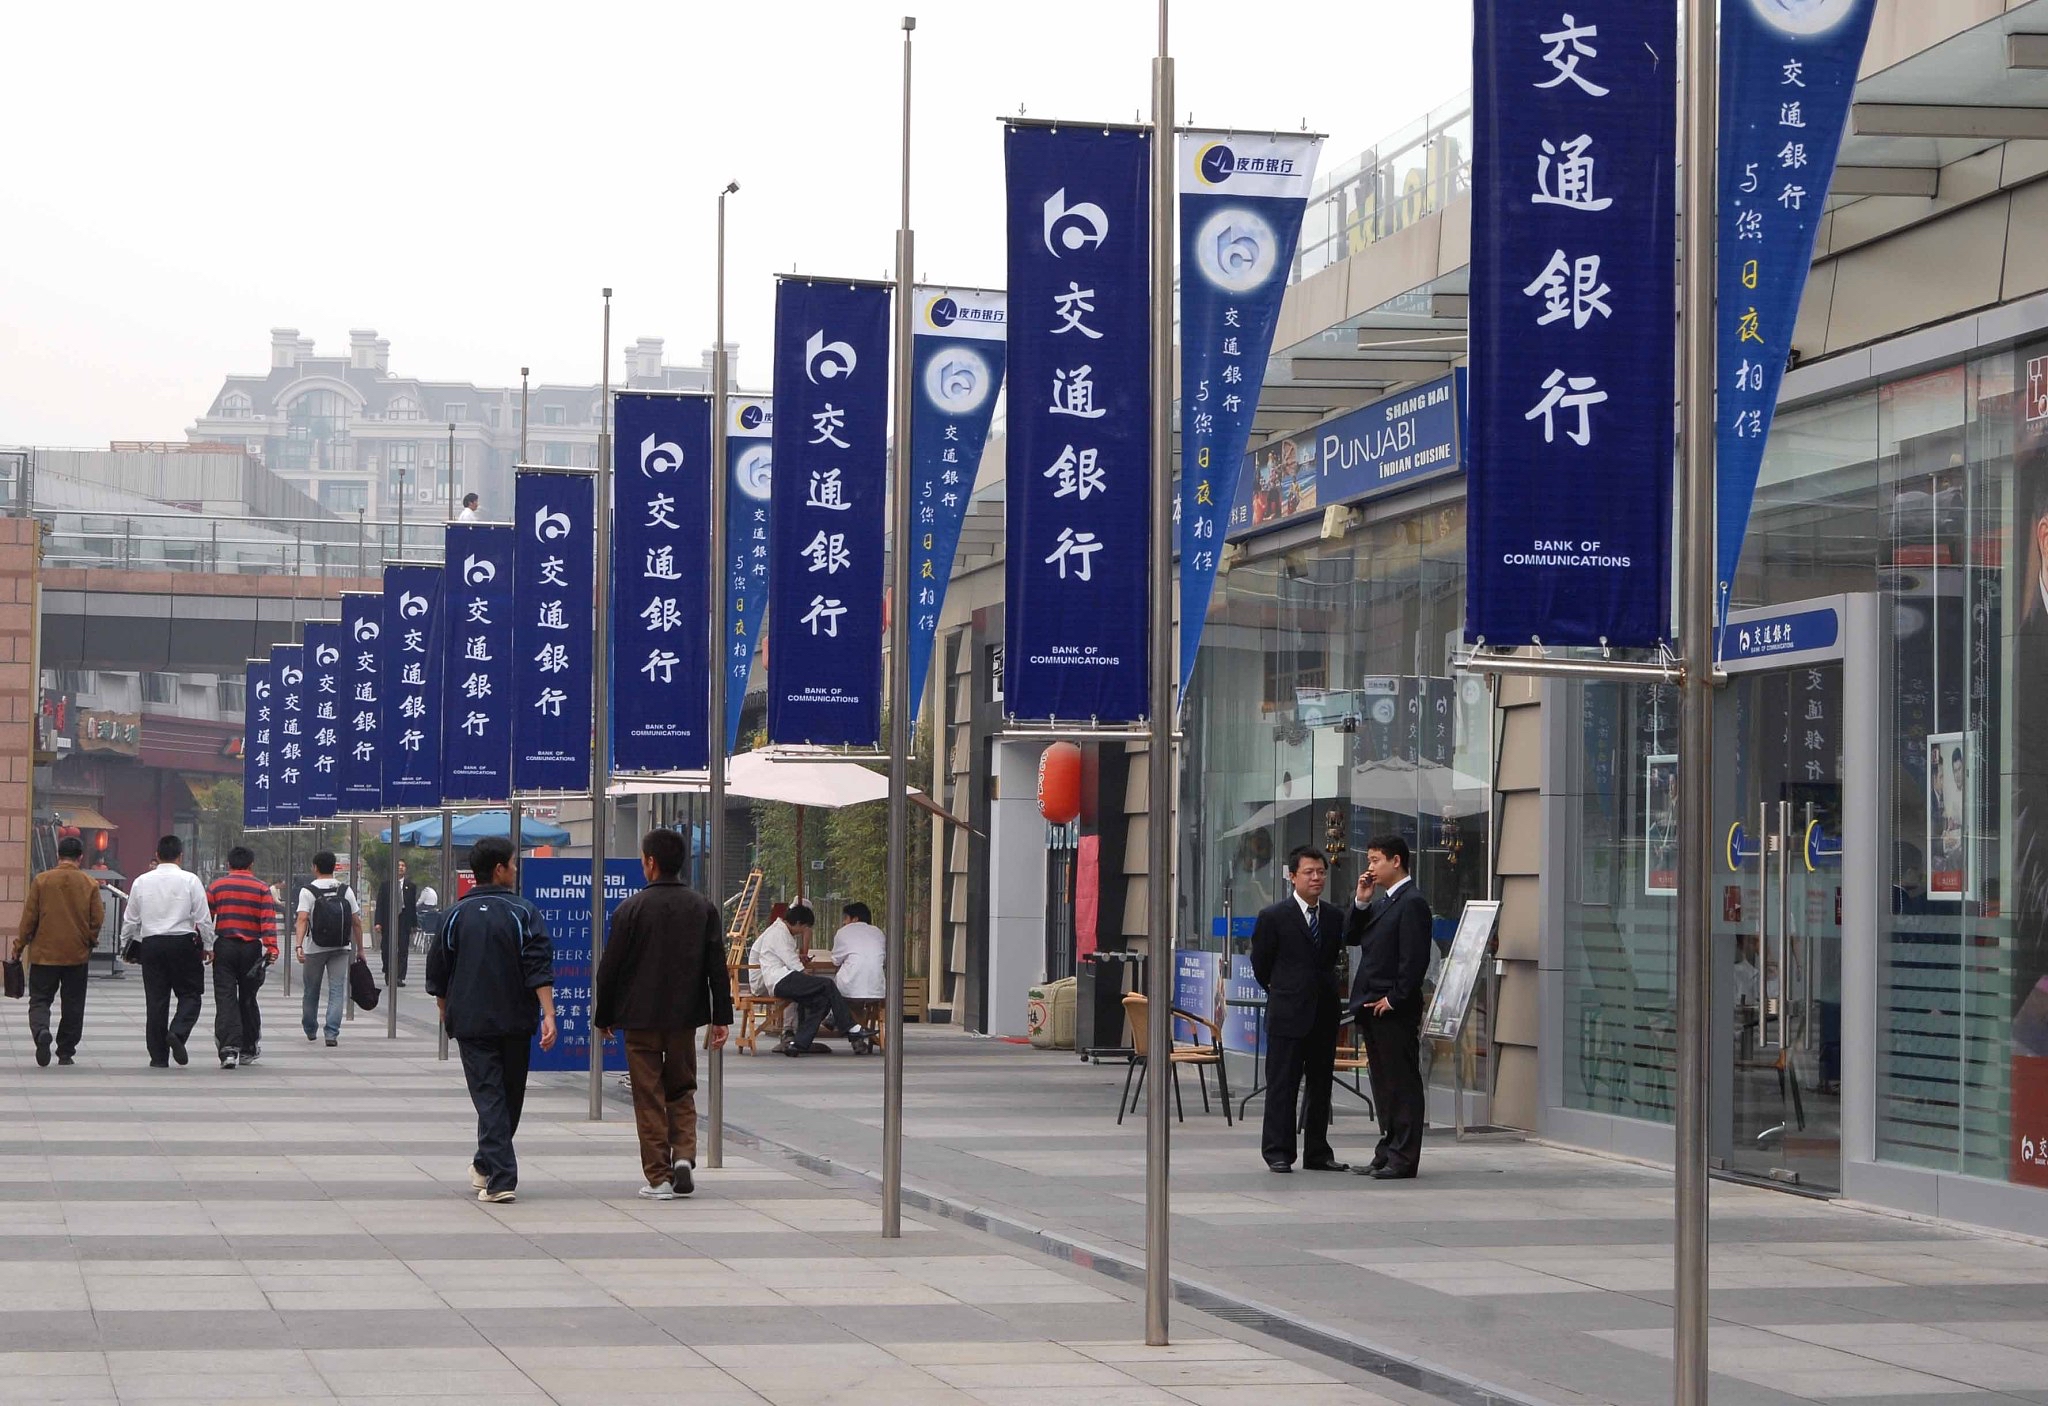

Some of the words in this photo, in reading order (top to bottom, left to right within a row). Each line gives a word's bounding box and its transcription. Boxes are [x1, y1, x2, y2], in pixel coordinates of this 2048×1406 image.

[1236, 156, 1294, 174] 夜市银行
[1776, 58, 1808, 211] 交通銀行
[1523, 13, 1614, 446] 交通銀行
[958, 307, 1005, 322] 夜市银行
[1222, 307, 1243, 413] 交通銀行
[1043, 281, 1107, 581] 交通銀行
[1386, 394, 1426, 422] SHANG
[1427, 385, 1450, 406] HAI
[941, 424, 959, 508] 交通銀行
[1322, 417, 1416, 477] PUNJABI
[1413, 442, 1451, 469] CUISINE
[751, 508, 767, 577] 交通銀行
[801, 402, 850, 637] 交通銀行
[1535, 541, 1574, 552] BANK
[1581, 541, 1601, 552] OF
[639, 492, 682, 684] 交通銀行
[1503, 554, 1631, 567] COMMUNICATIONS
[460, 596, 493, 738] 交通銀行
[535, 555, 570, 718] 交通銀行
[1031, 655, 1120, 665] COMMUNICATIONS
[1052, 646, 1079, 655] BANK
[1085, 646, 1098, 655] OF
[314, 674, 338, 774] 交通銀行
[352, 651, 377, 762] 交通銀行
[399, 628, 427, 752] 交通銀行
[787, 694, 859, 703] COMMUNICATIONS
[805, 687, 827, 695] BANK
[281, 693, 302, 784] 交通銀行
[536, 888, 585, 898] INDIAN
